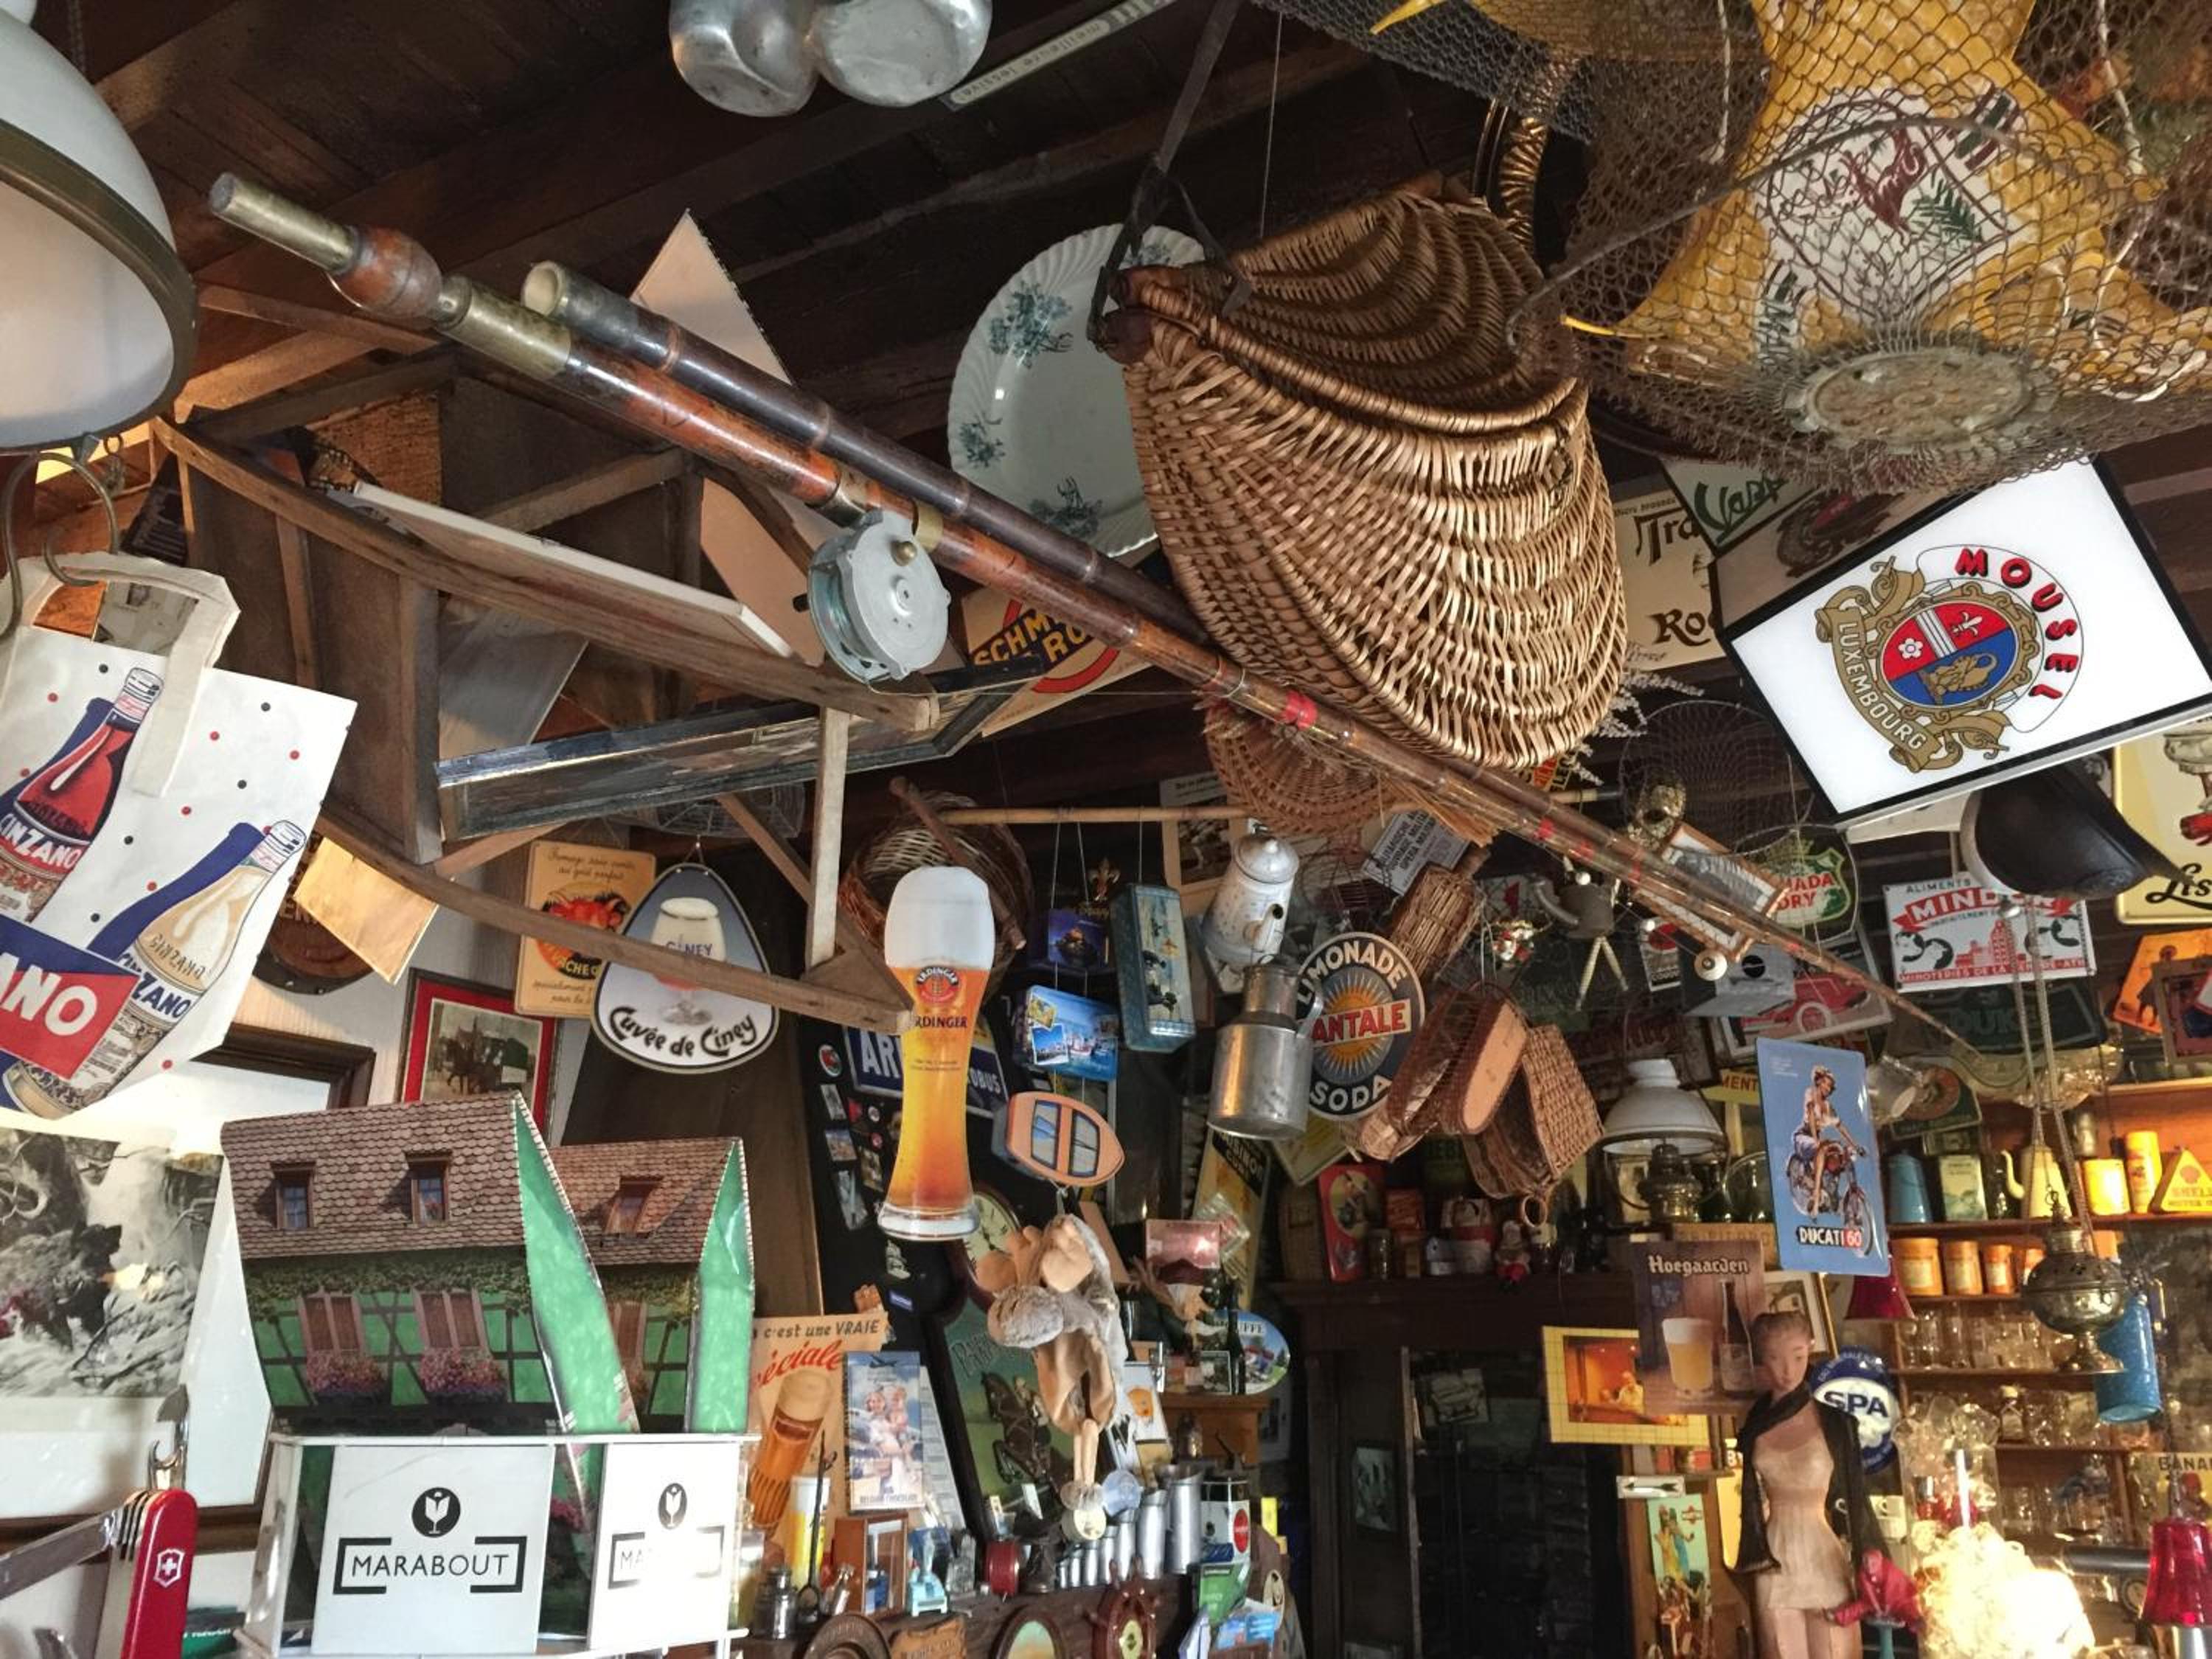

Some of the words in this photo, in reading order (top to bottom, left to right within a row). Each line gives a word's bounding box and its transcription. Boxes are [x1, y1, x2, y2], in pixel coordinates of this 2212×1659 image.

[1955, 547, 2079, 700] MOUSEL
[1837, 620, 1927, 751] LUXEMBOURG
[1298, 940, 1408, 1006] LIMONADE
[610, 1006, 667, 1050] Cuvée
[669, 1035, 695, 1057] de
[700, 1014, 757, 1057] Ciney
[916, 1015, 968, 1028] RDINGER
[1310, 1002, 1408, 1044] ANTALE
[1310, 1077, 1393, 1112] SODA
[1799, 1227, 1844, 1246] DUCATI
[1846, 1229, 1863, 1247] 60
[1649, 1255, 1750, 1277] Hoegaarden
[805, 1326, 831, 1338] une
[836, 1319, 880, 1336] VRAIE
[351, 1554, 510, 1578] MARABOUT
